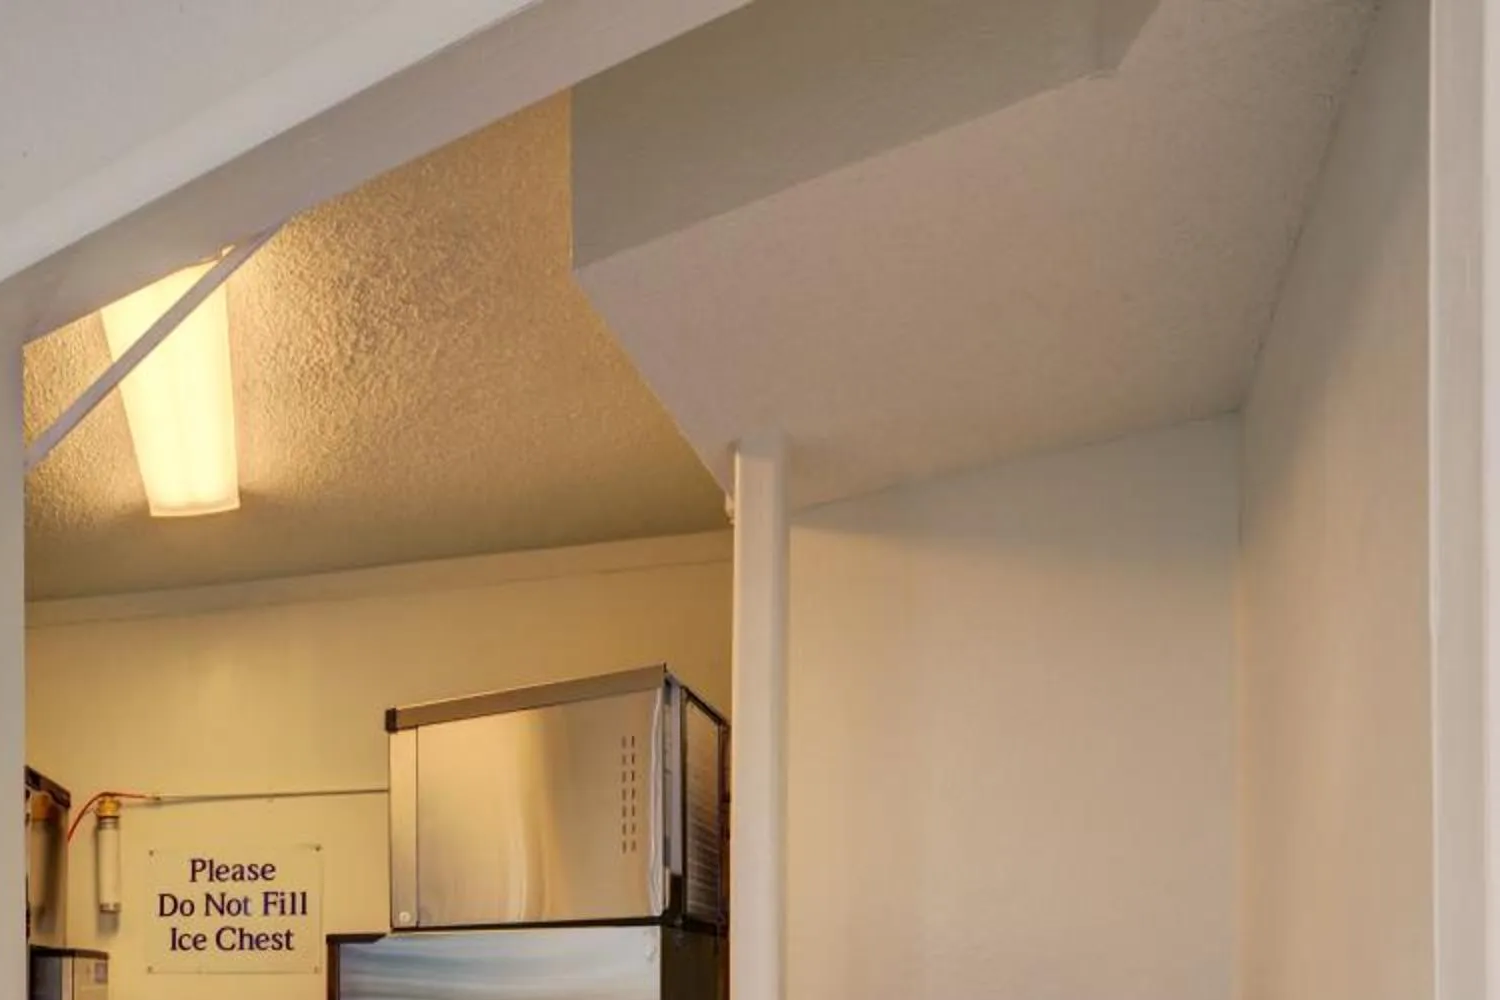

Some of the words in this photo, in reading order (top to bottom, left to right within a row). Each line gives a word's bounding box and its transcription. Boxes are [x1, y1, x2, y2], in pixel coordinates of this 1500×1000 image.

[189, 858, 276, 882] Please
[158, 893, 195, 917] Do
[204, 893, 252, 917] Not
[262, 892, 308, 916] Fill
[170, 928, 207, 951] Ice
[215, 926, 295, 951] Chest
